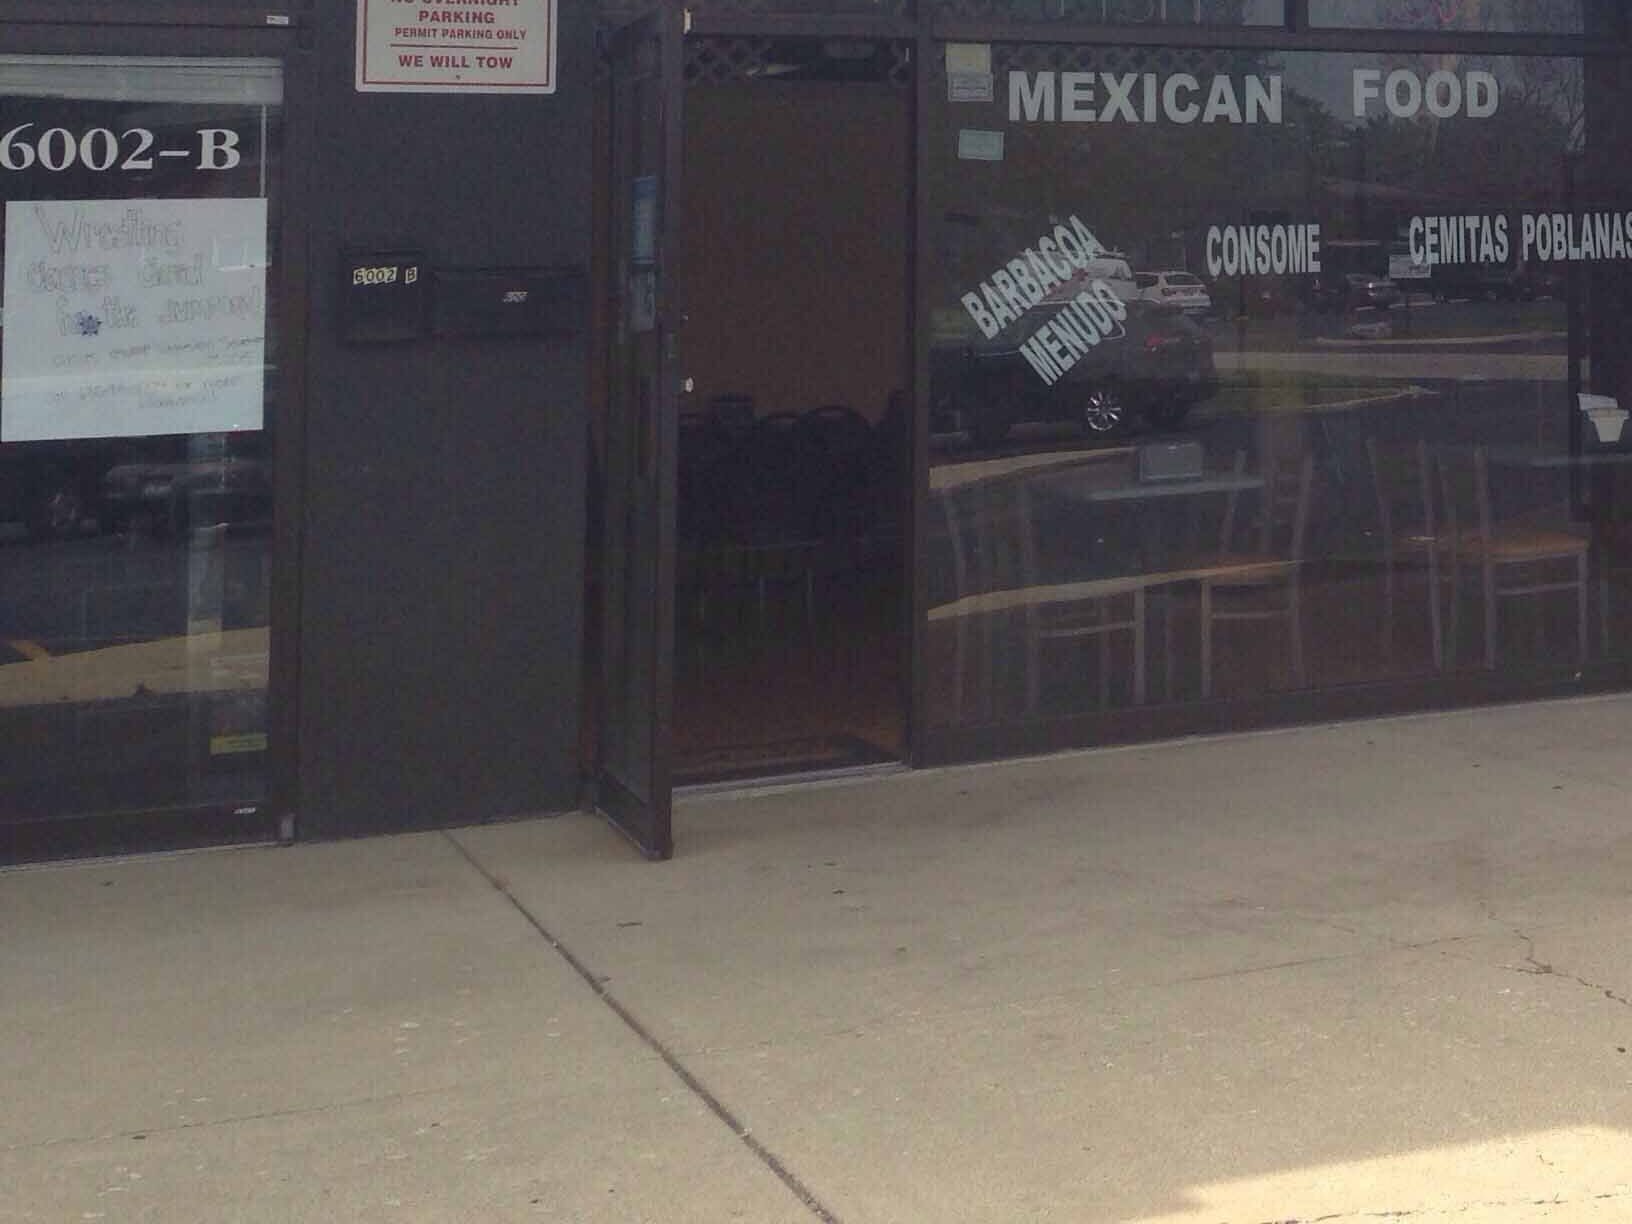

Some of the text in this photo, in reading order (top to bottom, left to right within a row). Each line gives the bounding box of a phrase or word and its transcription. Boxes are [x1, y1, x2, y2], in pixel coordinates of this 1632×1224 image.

[395, 27, 527, 41] PERMIT PARKING ONLY
[418, 10, 496, 24] PARKING
[398, 55, 513, 69] WE WILL TOW
[1008, 70, 1283, 124] MEXICAN
[1352, 68, 1499, 119] FOOD
[0, 123, 240, 172] 6002-B
[1206, 223, 1321, 277] CONSOME
[1408, 215, 1509, 265] CEMITAS
[354, 267, 396, 284] 6002
[960, 214, 1107, 340] BARBACOA
[1018, 280, 1128, 386] MENUDO
